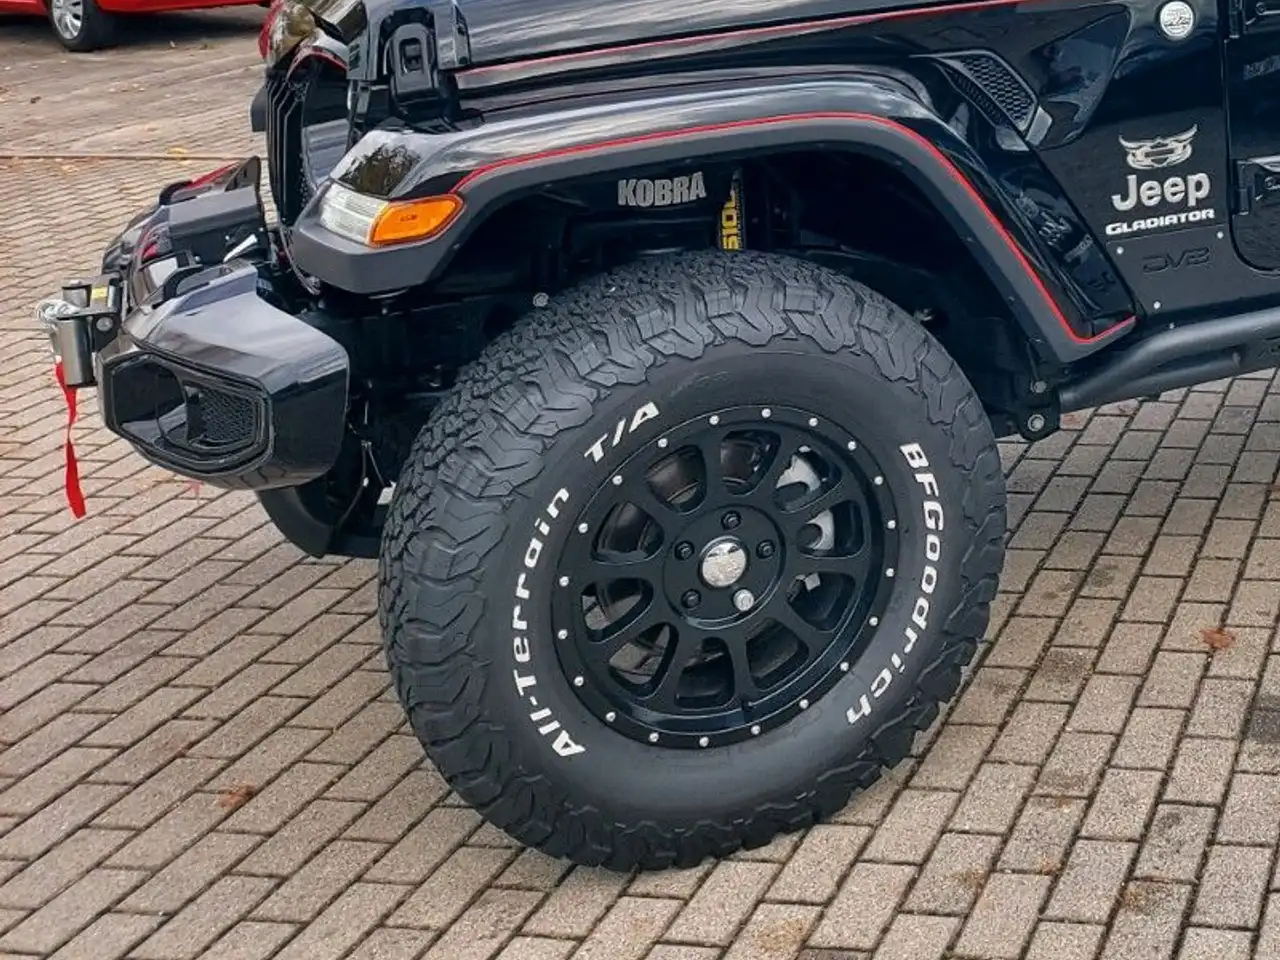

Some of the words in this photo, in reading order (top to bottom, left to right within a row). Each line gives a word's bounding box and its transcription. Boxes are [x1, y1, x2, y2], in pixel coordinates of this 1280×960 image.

[617, 171, 707, 207] KOBRA
[1111, 173, 1211, 211] Jeep
[1105, 208, 1215, 235] GLADIATOR
[512, 487, 586, 758] All-Terrain
[583, 401, 660, 465] T/A
[846, 442, 945, 725] BFGoodrich
